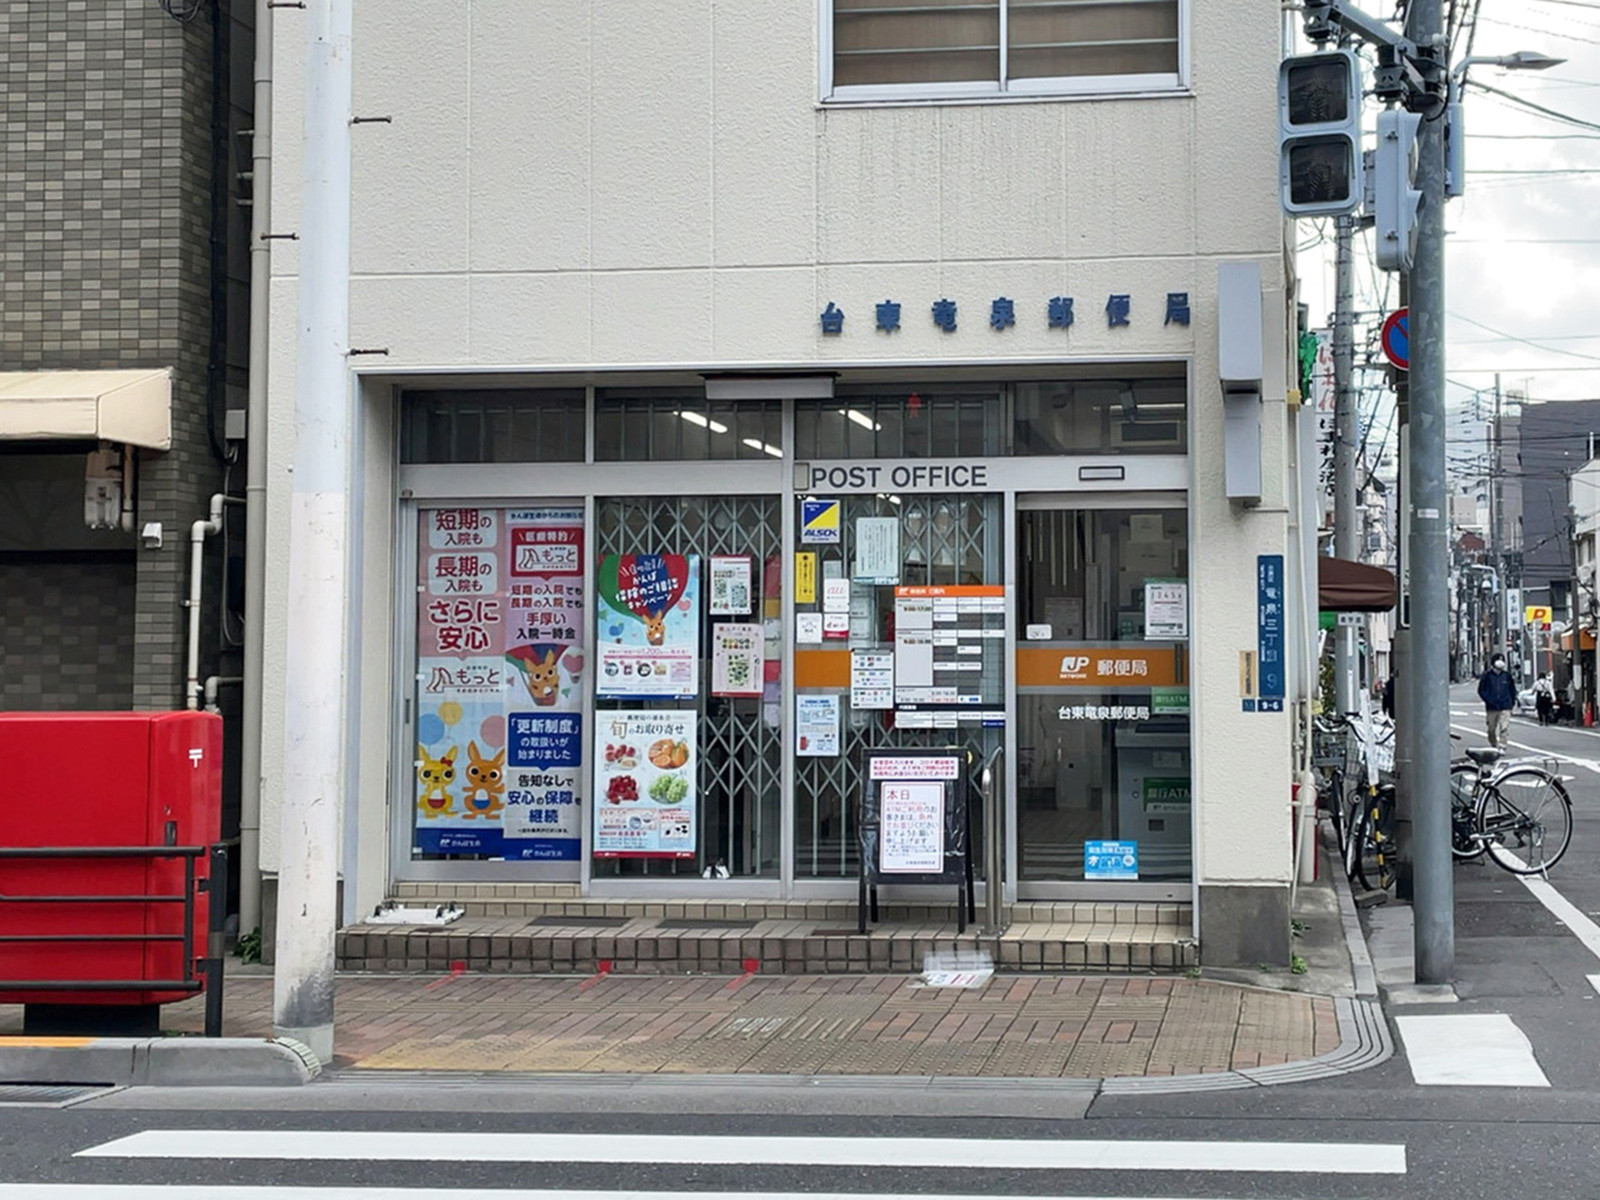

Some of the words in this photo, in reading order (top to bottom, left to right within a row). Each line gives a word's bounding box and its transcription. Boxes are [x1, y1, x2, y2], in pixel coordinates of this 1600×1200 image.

[820, 293, 1191, 333] 台東竜泉郵便局
[812, 466, 882, 489] POST
[891, 464, 988, 488] OFFICE
[435, 509, 493, 532] 短期の
[444, 532, 484, 546] 入院も
[804, 528, 838, 537] ALSOK
[541, 548, 577, 562] もっと
[435, 555, 493, 577] 長期の
[444, 580, 484, 594] 入院も
[428, 600, 500, 624] さらに
[526, 612, 567, 626] 手厚い
[1533, 608, 1547, 620] P
[438, 627, 490, 651] 安心
[516, 629, 577, 641] 入院一時金
[1060, 656, 1090, 673] JP
[1096, 660, 1148, 677] 郵便局
[455, 669, 501, 685] もっと
[1266, 673, 1278, 689] 9
[1058, 705, 1150, 721] 台東竜泉郵便局
[518, 750, 572, 761] 始まりました
[519, 774, 574, 787] 告知なしで
[528, 809, 559, 825] 継続
